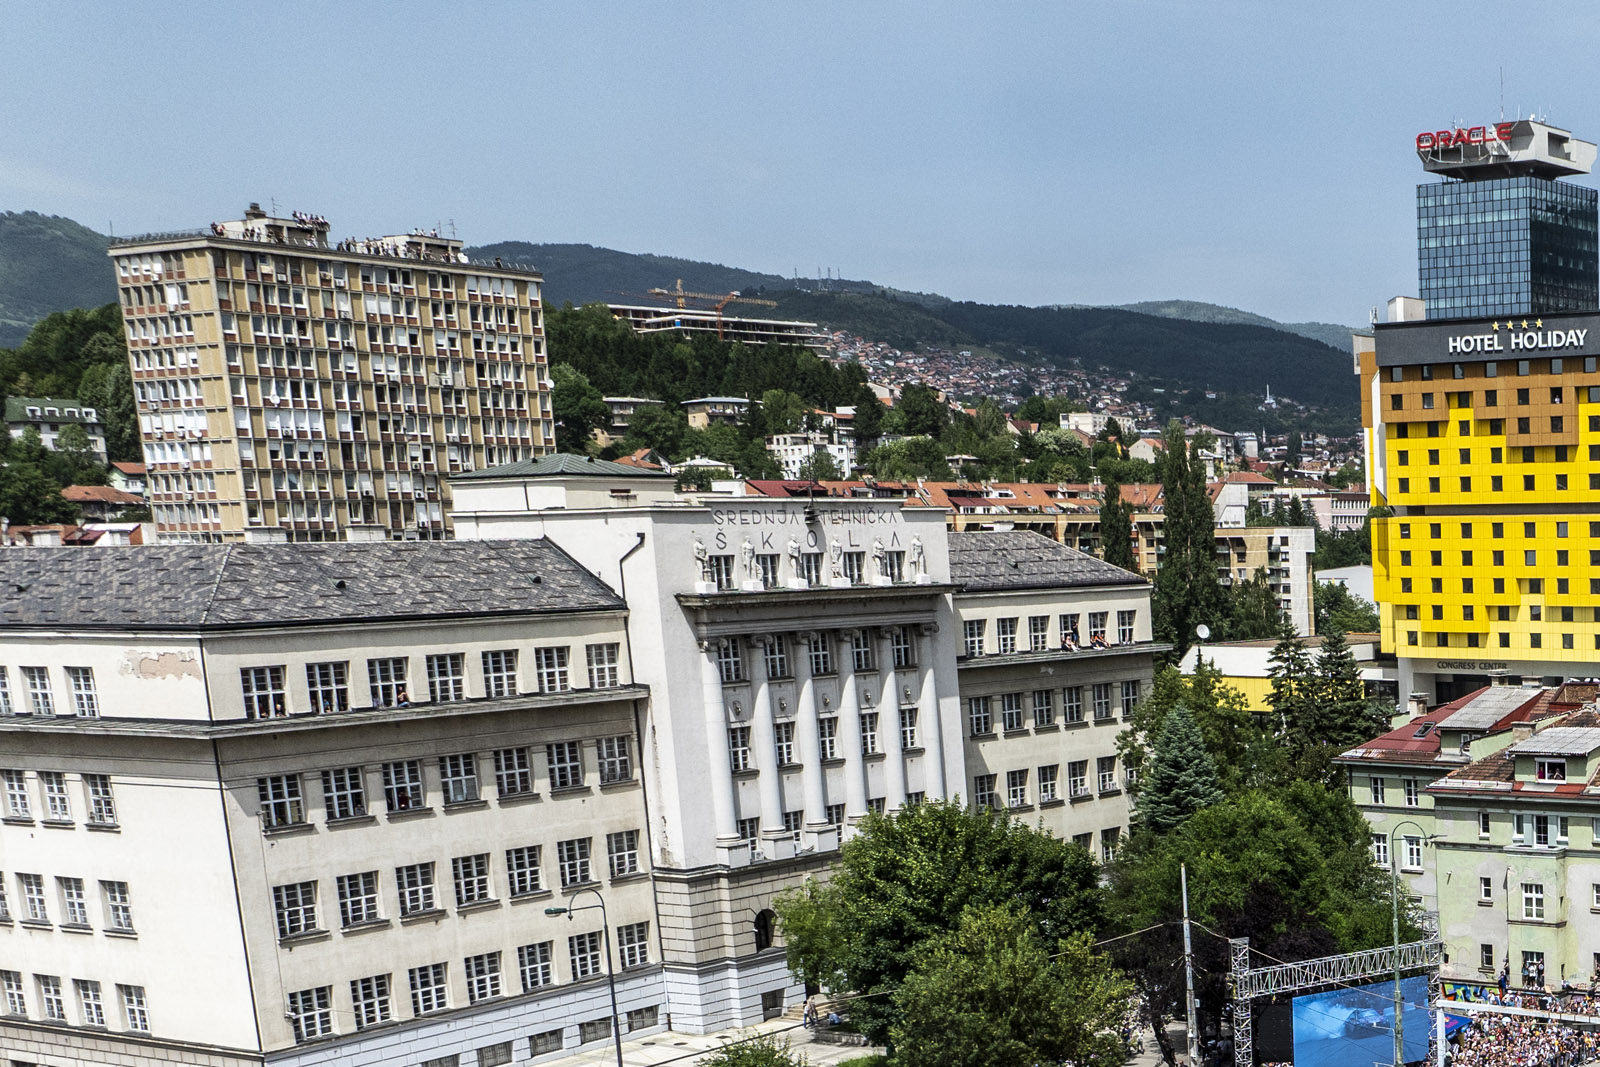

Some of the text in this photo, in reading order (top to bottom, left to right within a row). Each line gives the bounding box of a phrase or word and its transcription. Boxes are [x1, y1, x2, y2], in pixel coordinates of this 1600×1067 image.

[1416, 122, 1512, 149] ORACLE
[1448, 329, 1588, 353] HOTEL HOLIDAY
[714, 506, 897, 526] SREDNJA TEHNIČKA
[1437, 661, 1507, 670] CONGRESS CENTER
